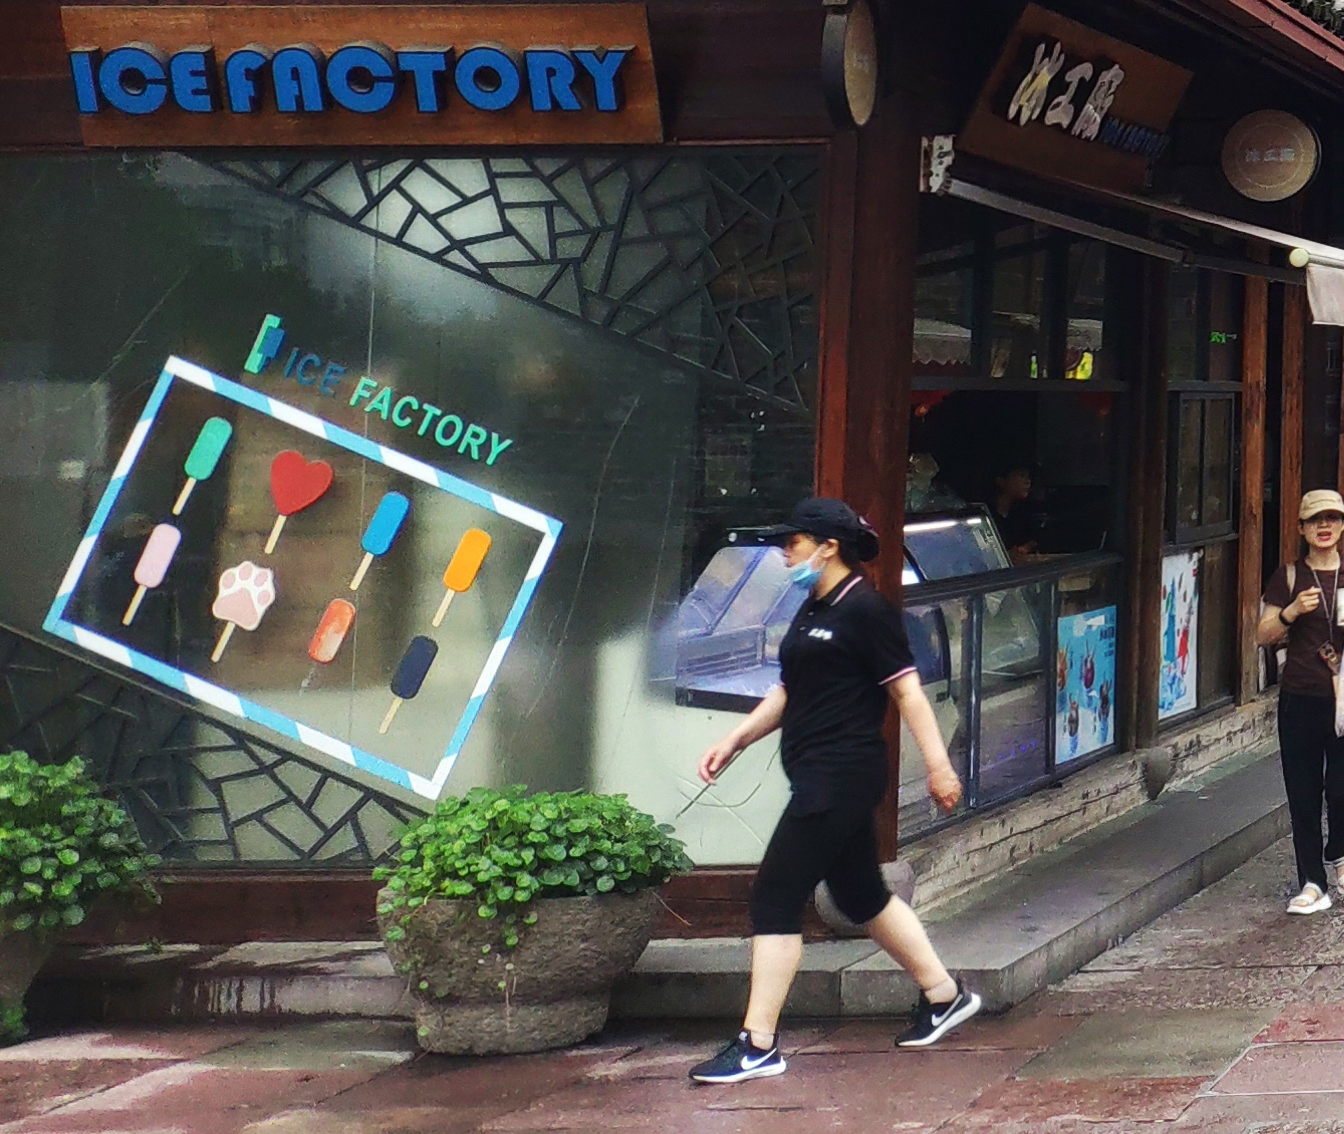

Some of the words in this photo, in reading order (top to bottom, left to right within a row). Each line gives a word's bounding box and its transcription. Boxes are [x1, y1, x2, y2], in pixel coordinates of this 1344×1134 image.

[69, 45, 214, 115] ICE
[224, 42, 636, 114] FACTORY
[283, 346, 347, 396] ICE
[348, 376, 514, 467] FACTORY
